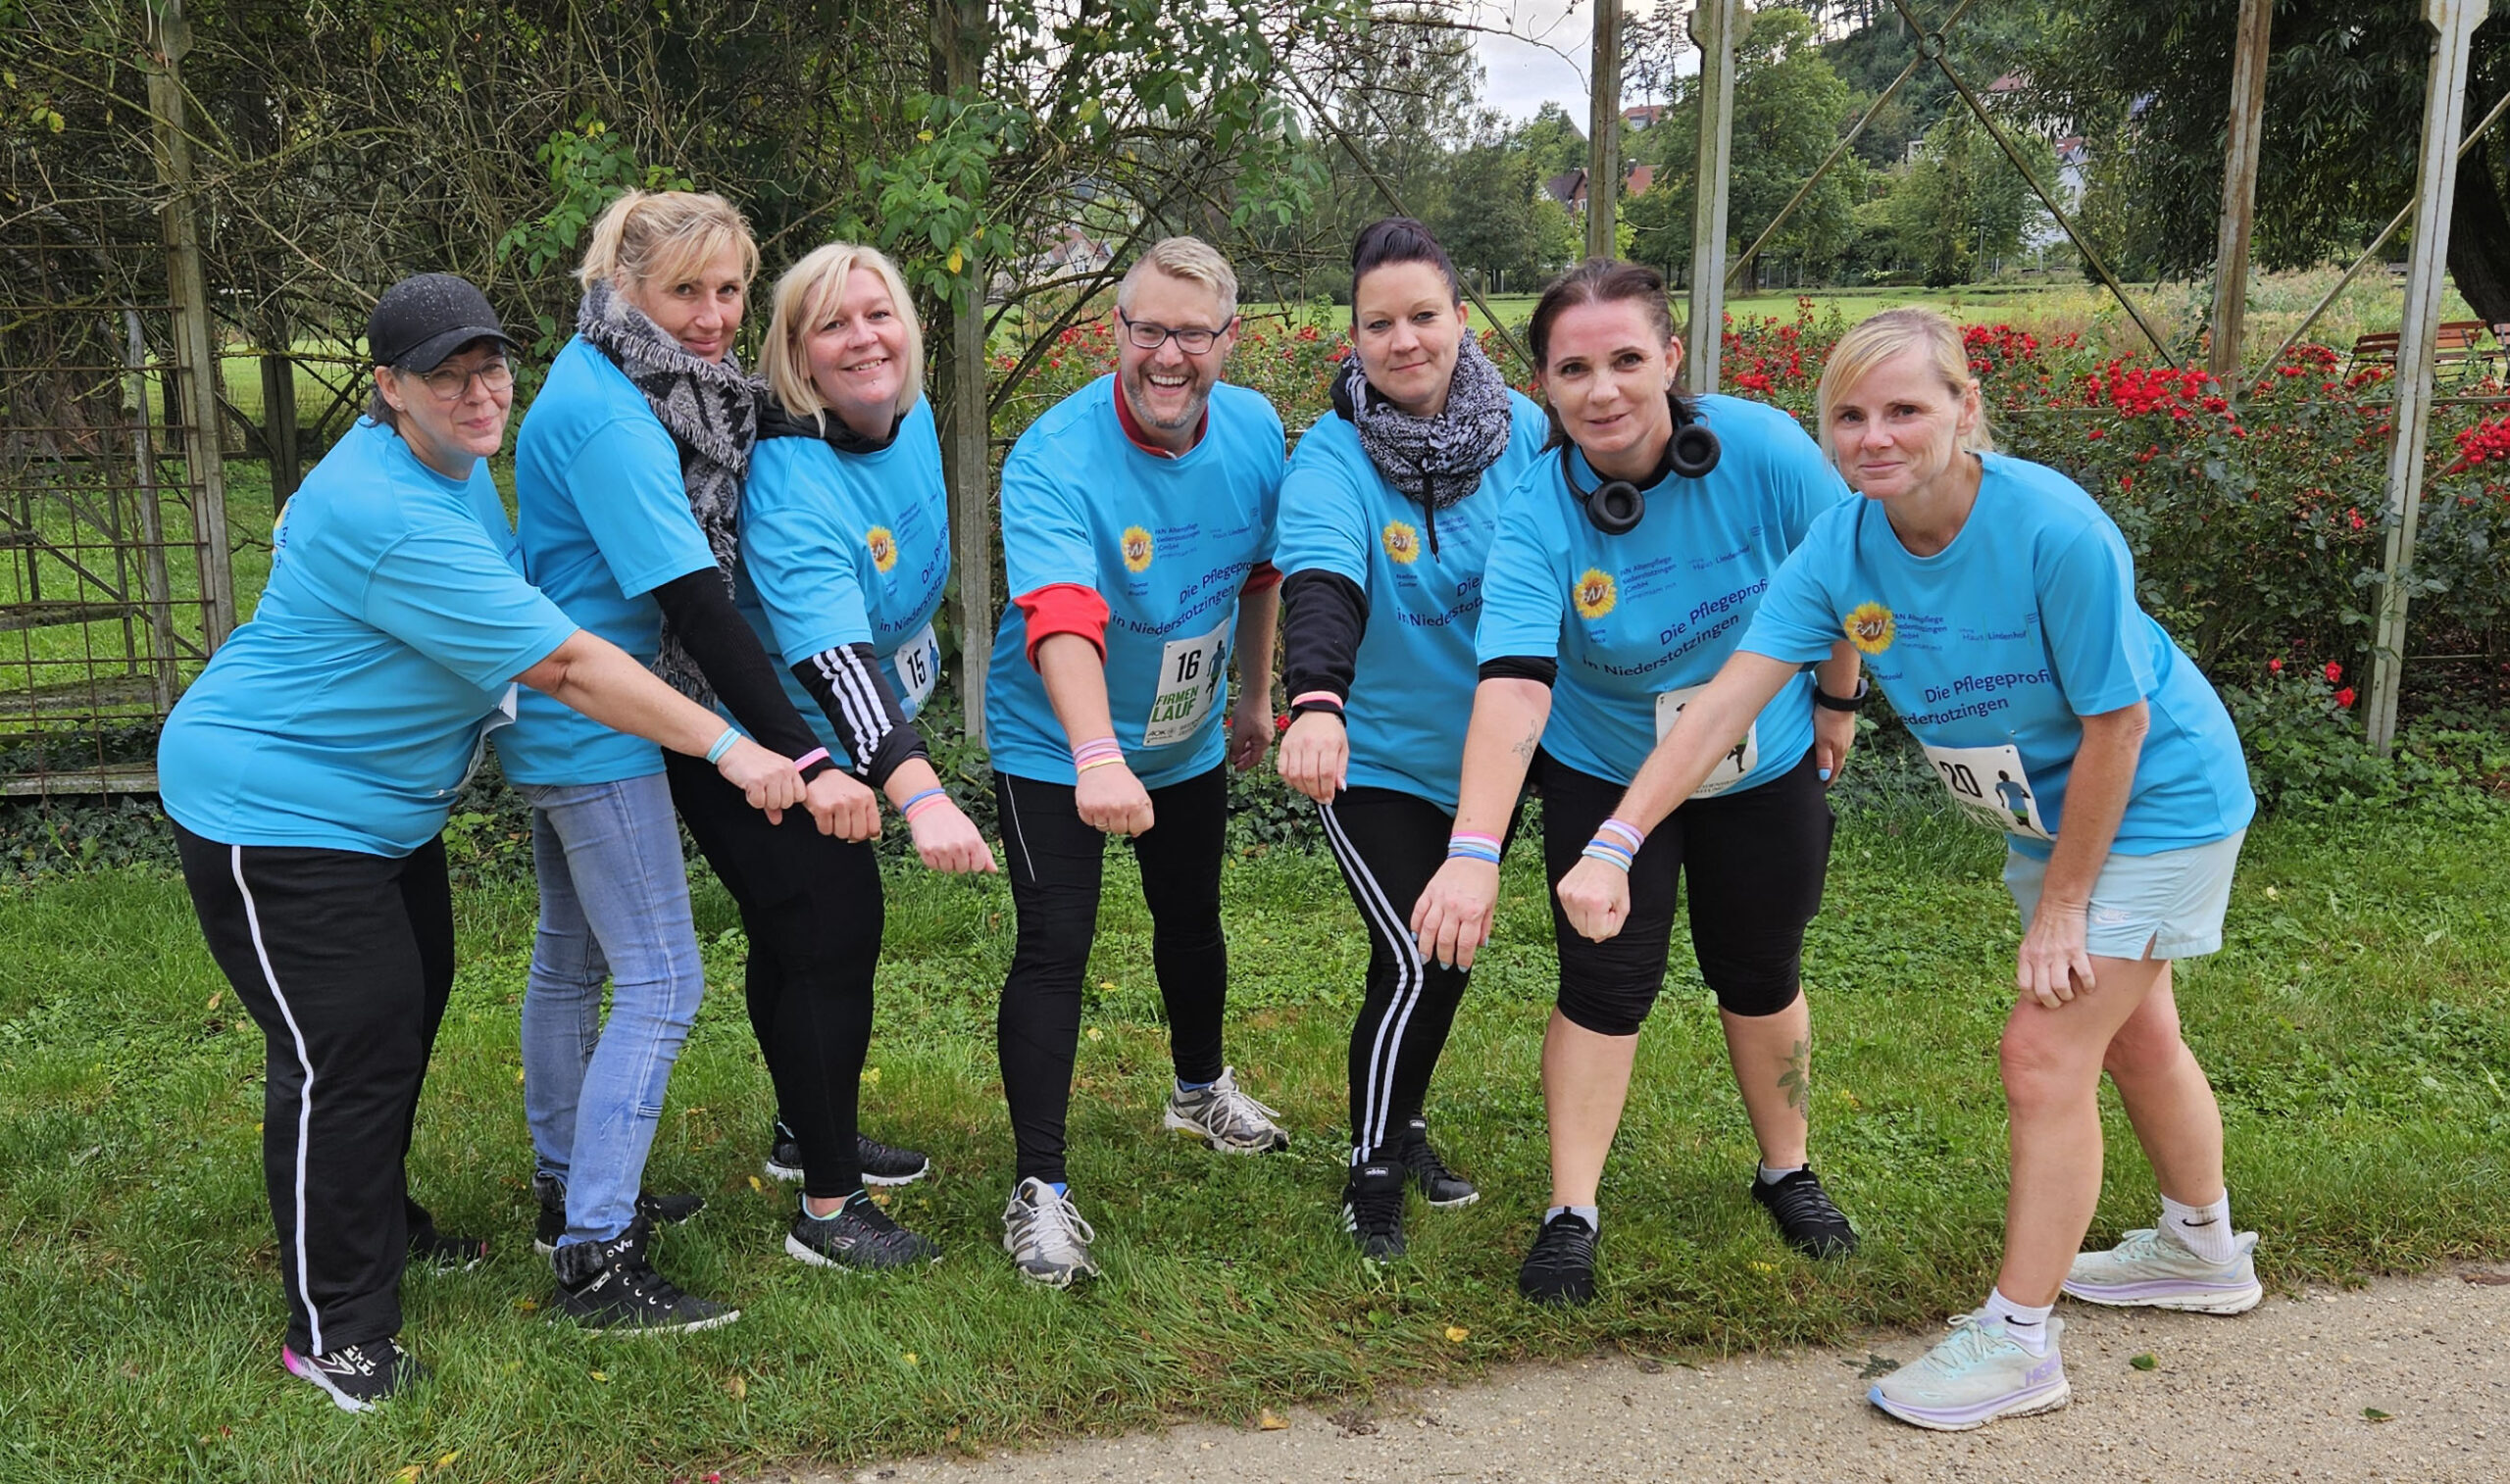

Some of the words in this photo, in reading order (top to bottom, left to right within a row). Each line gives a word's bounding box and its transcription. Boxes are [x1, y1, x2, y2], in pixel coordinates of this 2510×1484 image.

[922, 561, 935, 584] Die
[1180, 584, 1198, 605] Die
[1457, 576, 1481, 597] Die
[1112, 610, 1126, 628] in
[1130, 585, 1235, 636] Niederstotzingen
[879, 618, 890, 632] in
[1660, 622, 1686, 646] Die
[1582, 655, 1599, 670] in
[1604, 614, 1740, 676] Niederstotzingen
[907, 648, 927, 689] 15
[1177, 649, 1202, 683] 16
[1156, 685, 1199, 706] FIRMEN
[1925, 686, 1951, 704] Die
[1953, 668, 2051, 695] Pflegeprofi
[1151, 698, 1196, 722] LAUF
[1938, 761, 1983, 799] 20
